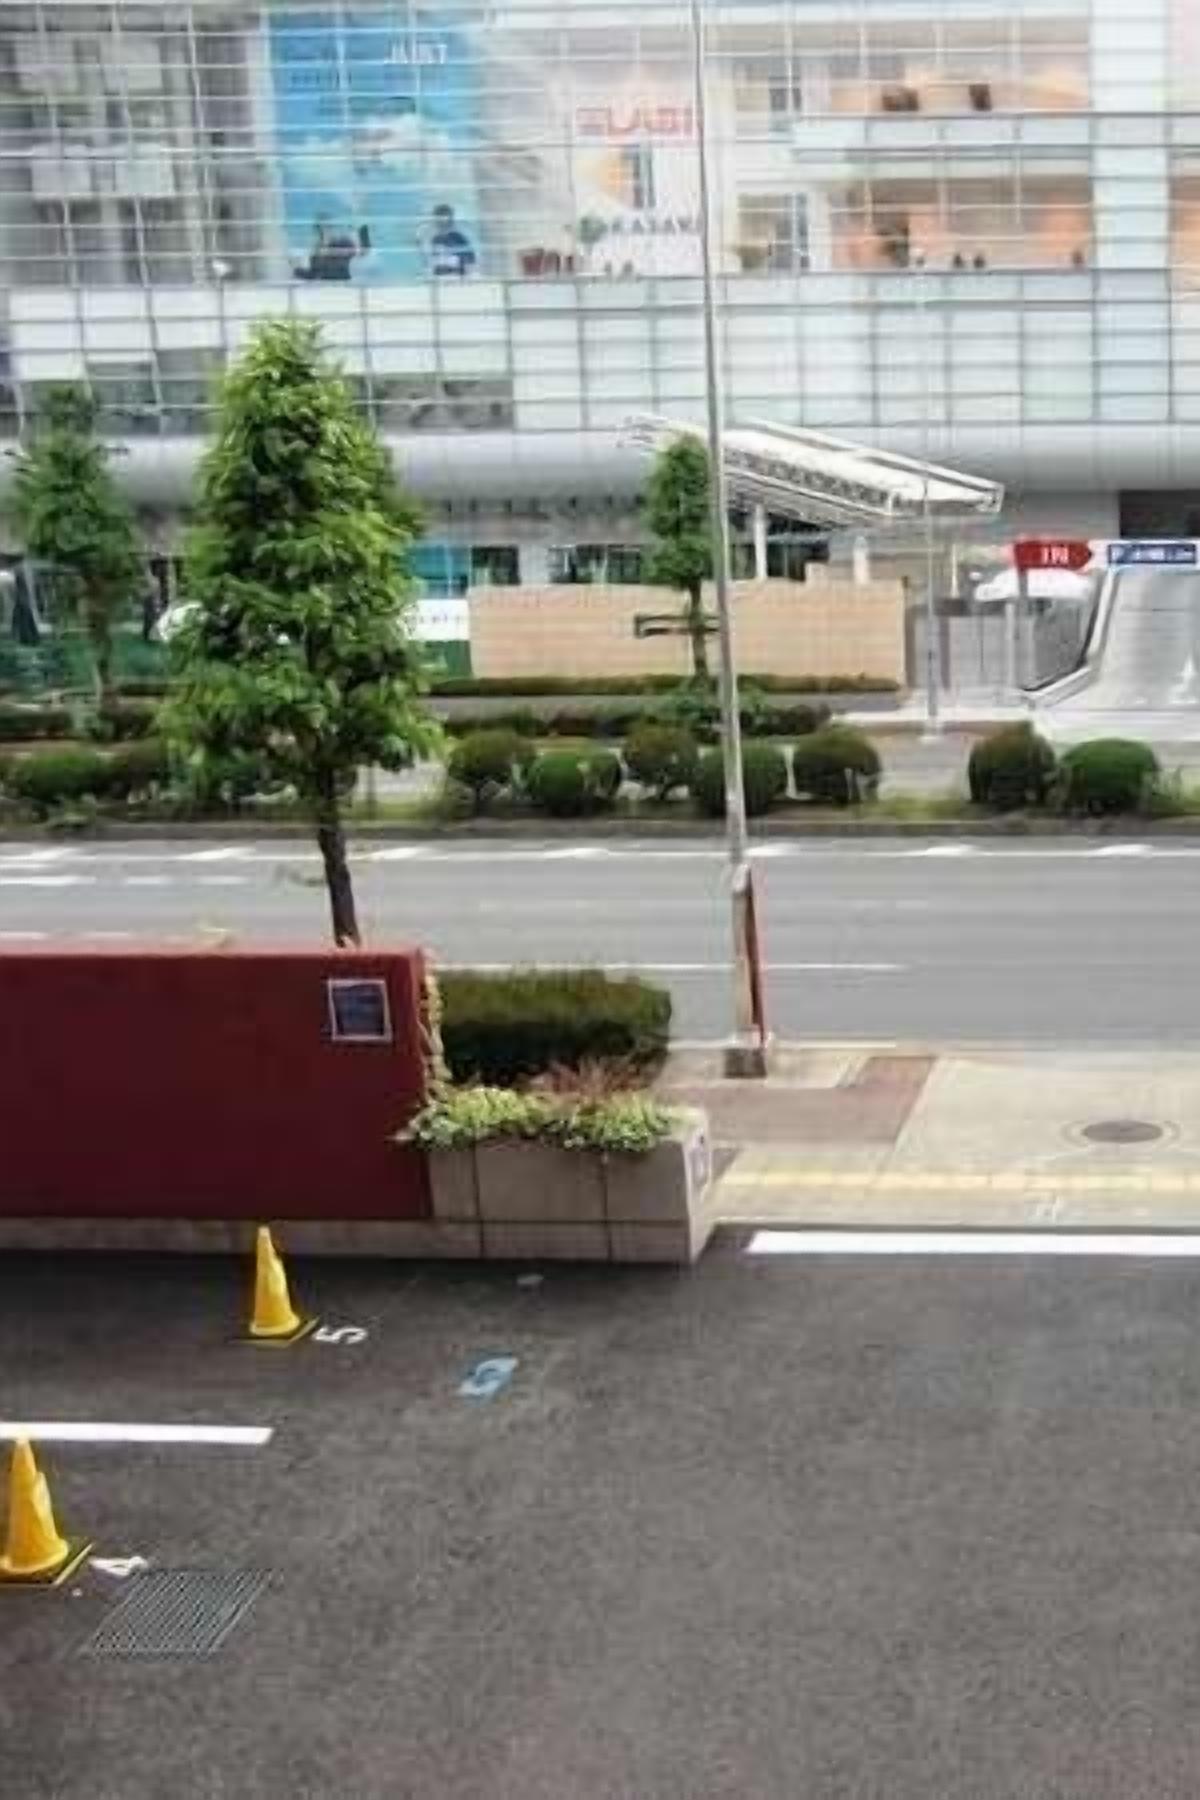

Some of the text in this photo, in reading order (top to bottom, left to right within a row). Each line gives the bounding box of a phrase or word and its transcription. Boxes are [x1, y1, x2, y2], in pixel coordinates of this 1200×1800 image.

[1042, 546, 1069, 565] IN
[313, 1325, 368, 1344] 5
[90, 1555, 148, 1577] 4
